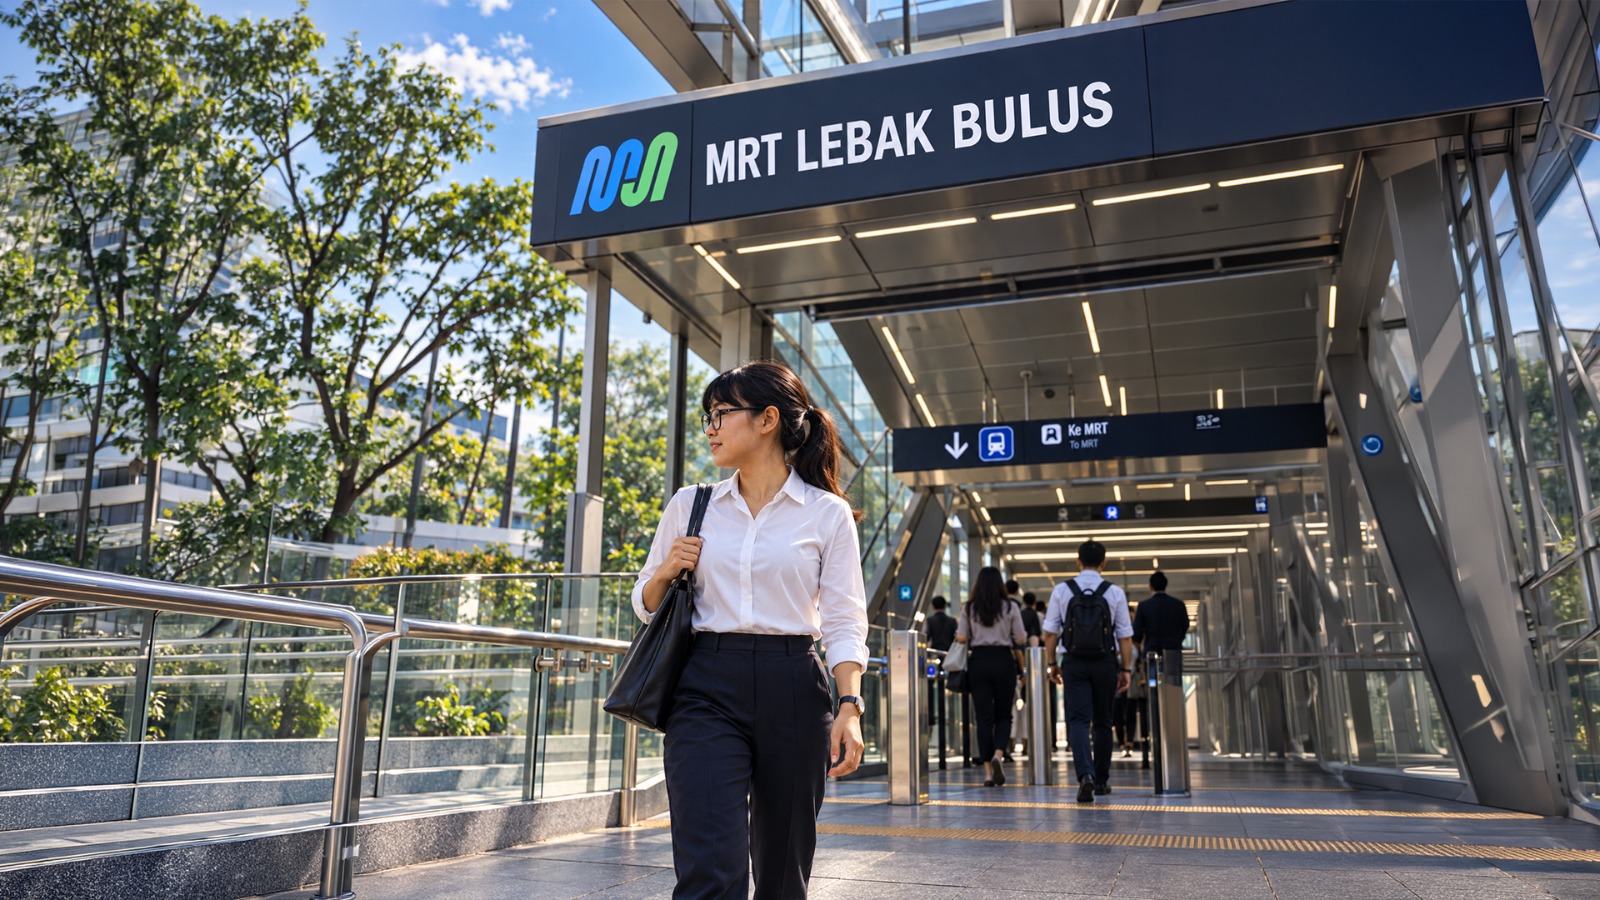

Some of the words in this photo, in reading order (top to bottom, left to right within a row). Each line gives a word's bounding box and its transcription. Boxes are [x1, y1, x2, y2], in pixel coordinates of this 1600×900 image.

[706, 131, 783, 186] MRT
[797, 108, 935, 172] LEBAK
[952, 81, 1113, 149] BULUS
[1068, 423, 1081, 436] Ke
[1084, 422, 1108, 435] MRT
[1069, 440, 1080, 449] To
[1081, 439, 1098, 448] MRT
